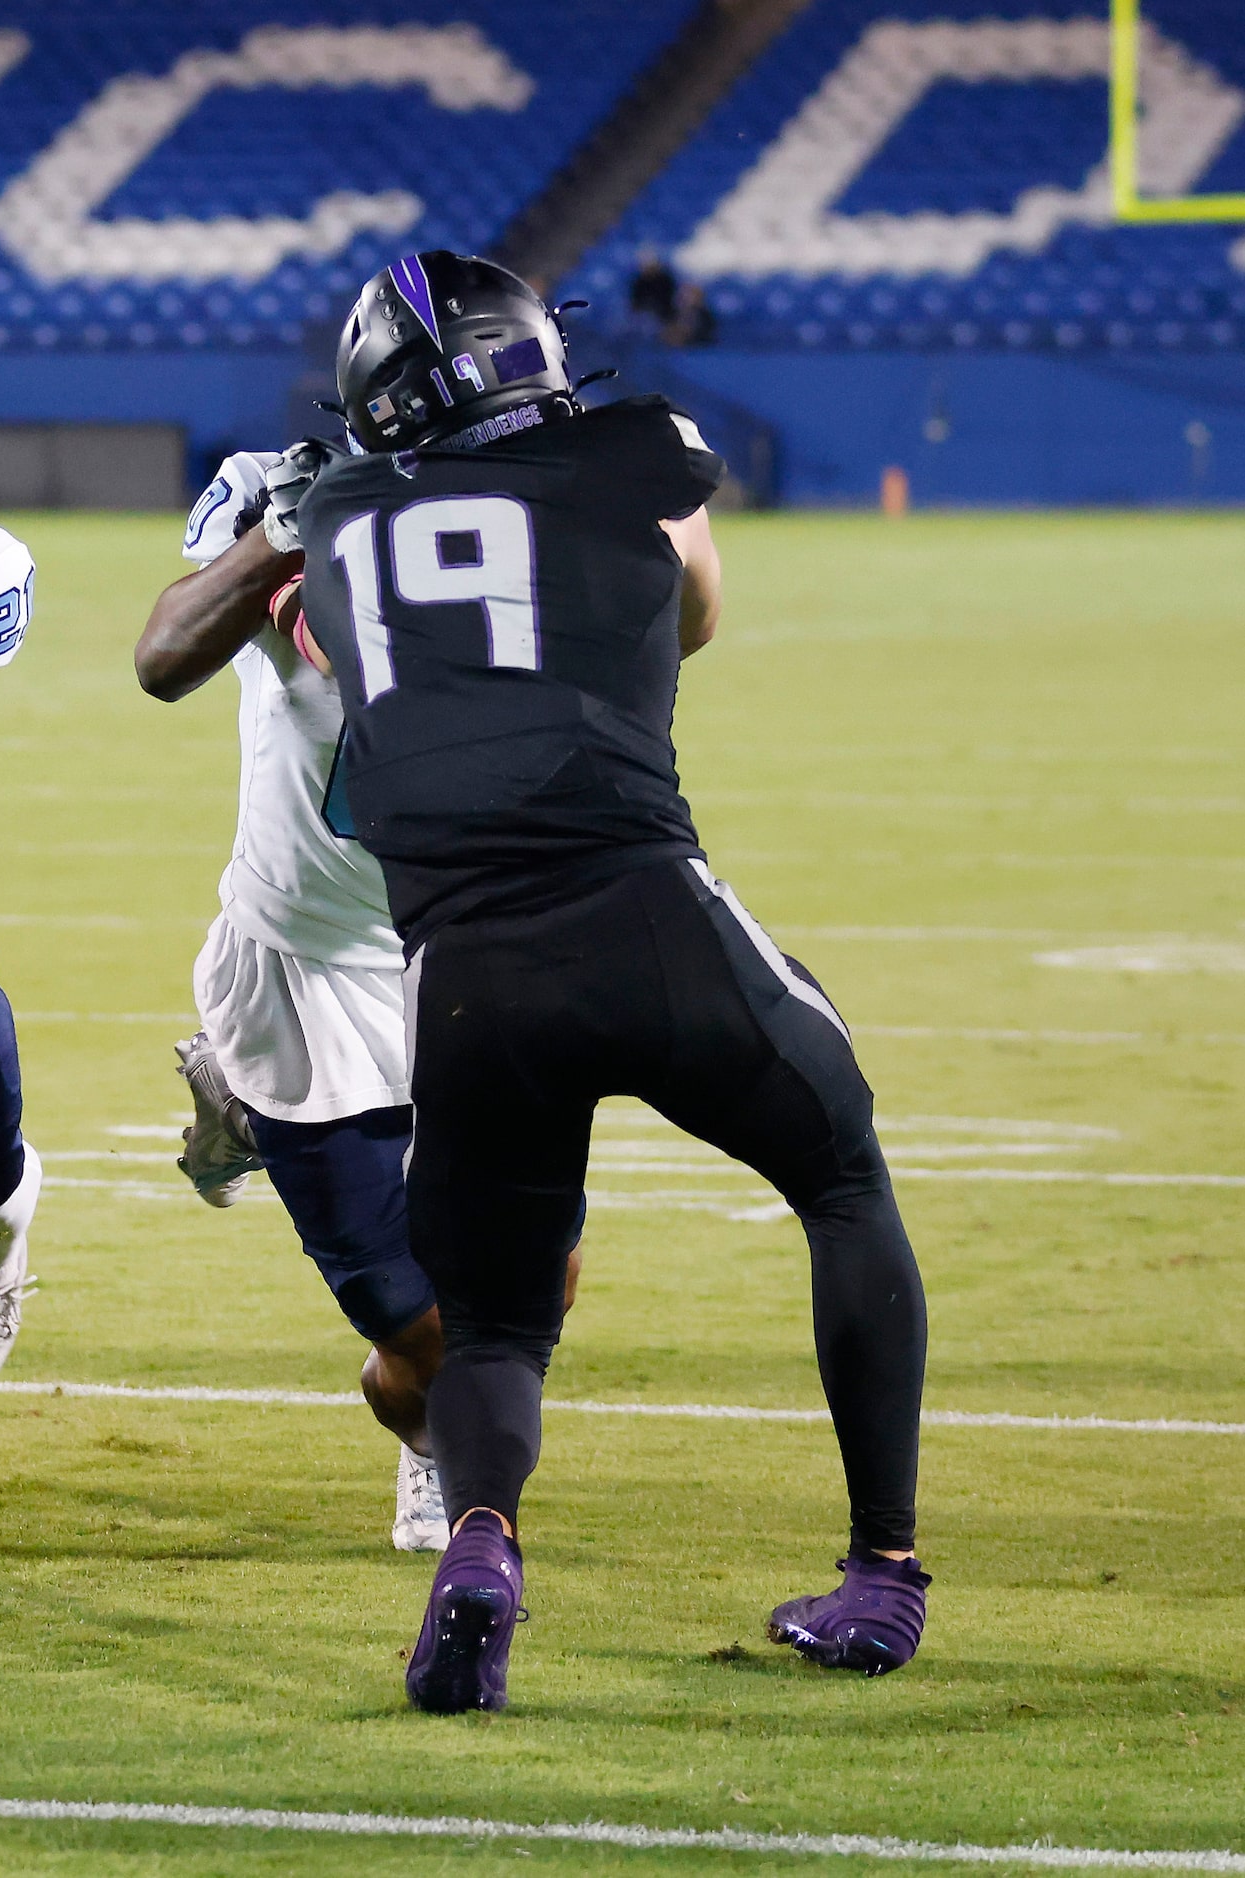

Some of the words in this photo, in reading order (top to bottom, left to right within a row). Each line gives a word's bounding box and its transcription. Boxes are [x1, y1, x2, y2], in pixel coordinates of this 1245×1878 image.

[429, 352, 485, 407] 19
[438, 403, 544, 452] PENDENCE
[330, 492, 542, 706] 19
